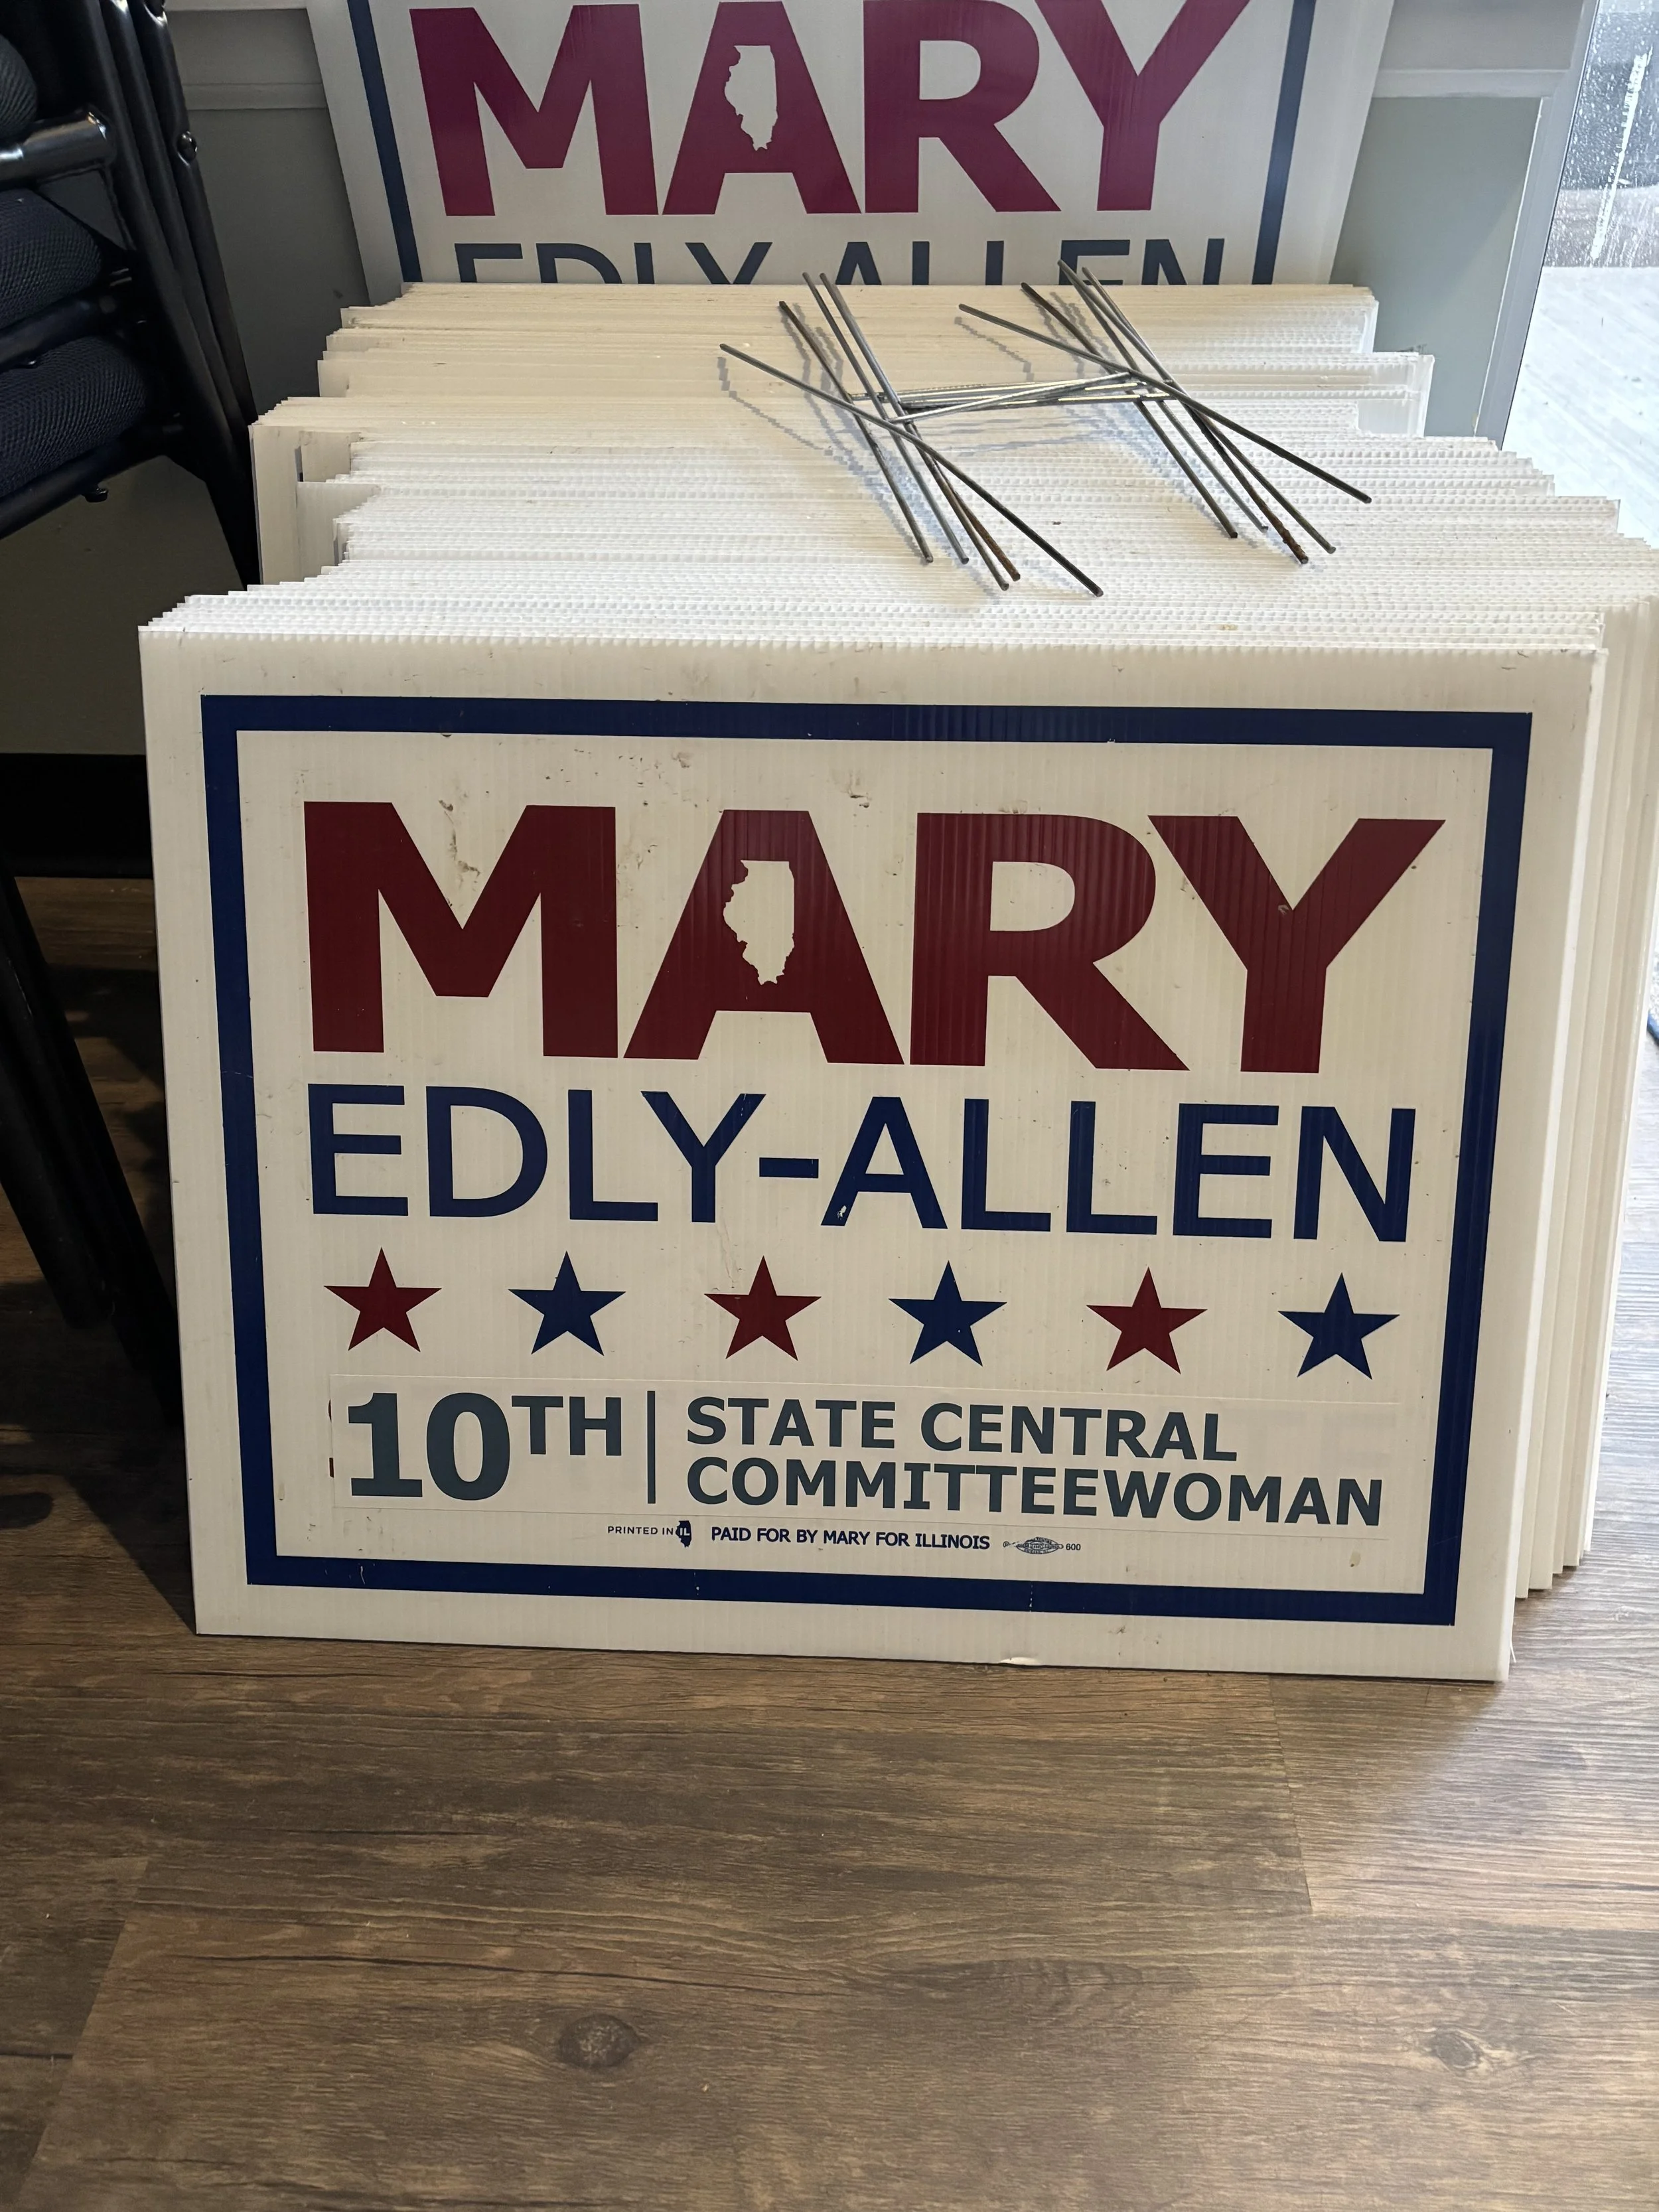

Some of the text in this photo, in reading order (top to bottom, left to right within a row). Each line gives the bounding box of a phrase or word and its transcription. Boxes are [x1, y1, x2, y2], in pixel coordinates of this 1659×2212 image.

[409, 0, 1250, 216] MARY
[304, 801, 1445, 1073] MARY
[308, 1084, 1415, 1242] EDLY-ALLEN
[348, 1392, 621, 1501] 10TH
[687, 1396, 1238, 1461] STATE CENTRAL
[607, 1526, 658, 1535] PRINTED
[662, 1527, 674, 1536] IN
[687, 1456, 1382, 1526] COMMITTEEWOMAN
[711, 1527, 990, 1550] PAID FOR BY MARY FOR ILLINOIS
